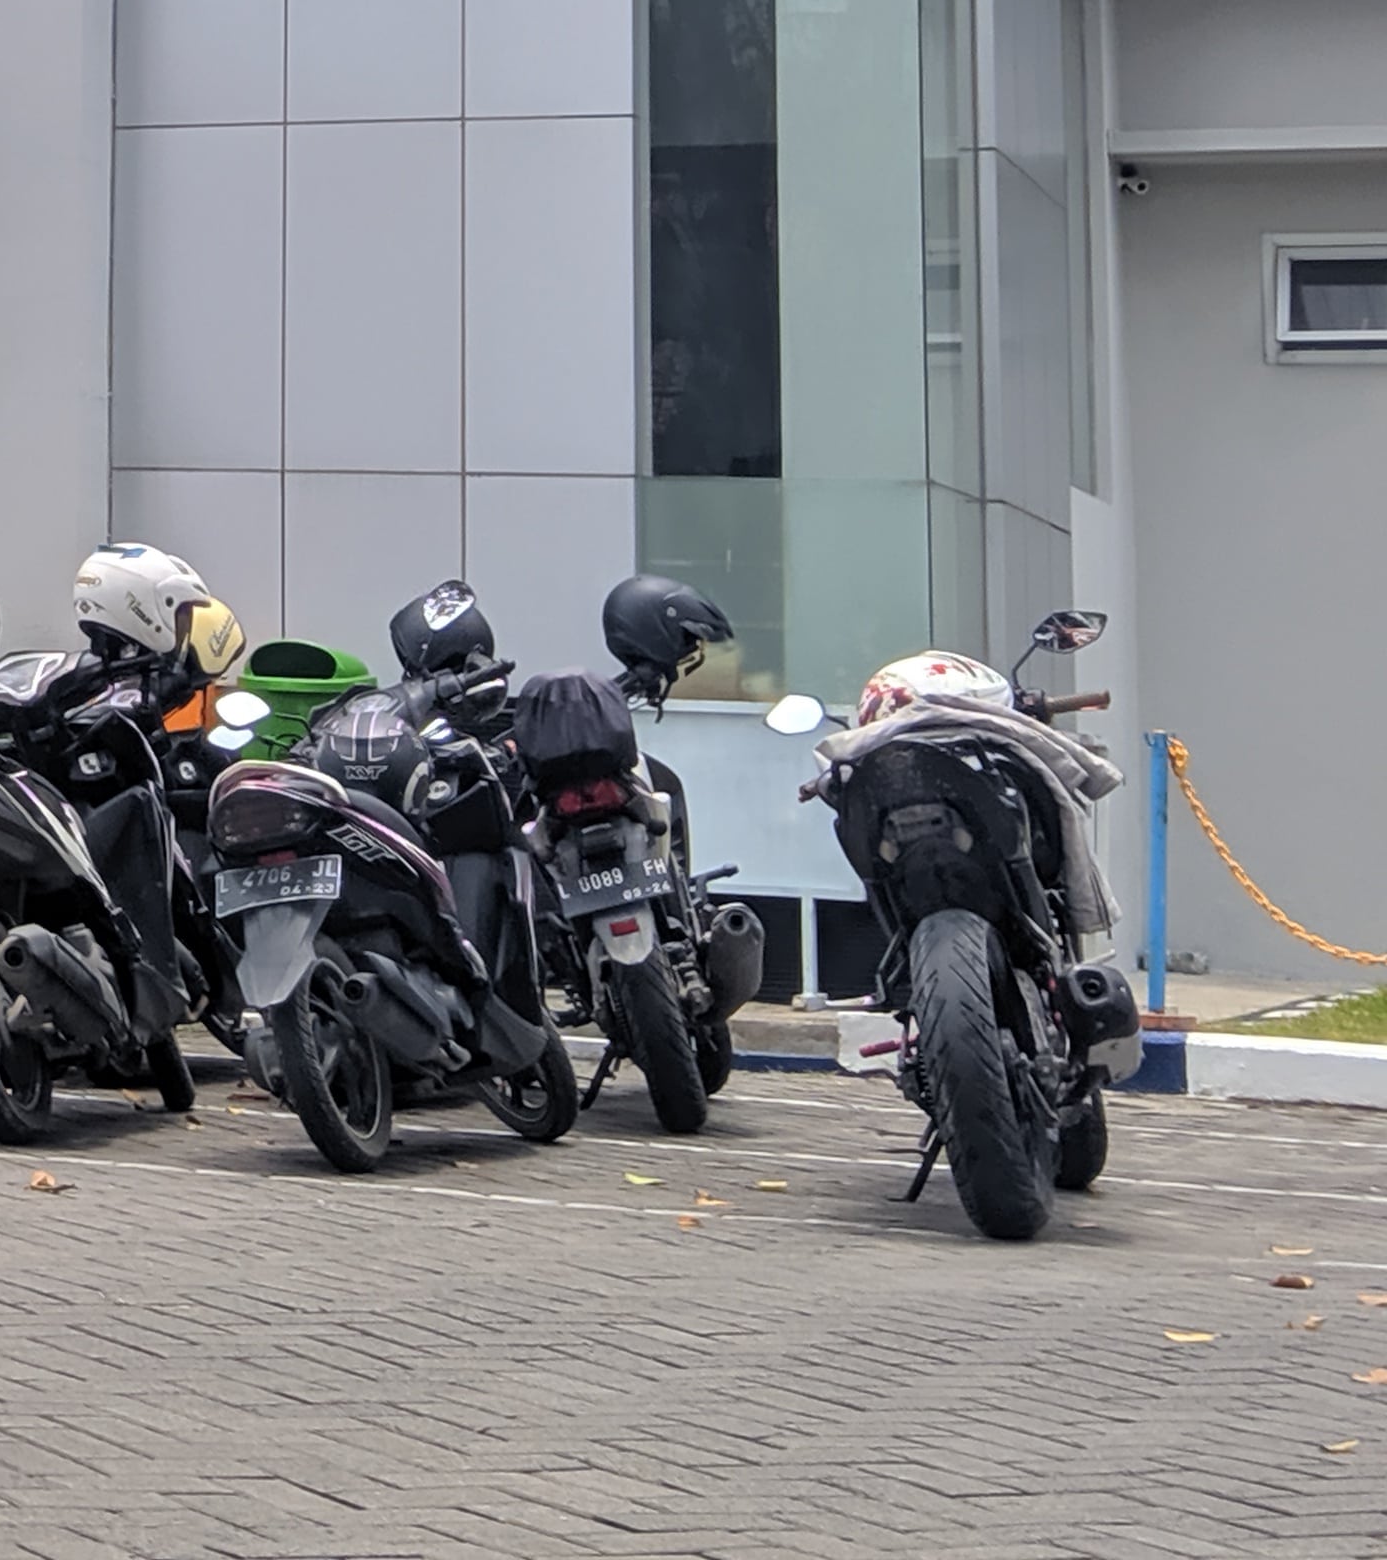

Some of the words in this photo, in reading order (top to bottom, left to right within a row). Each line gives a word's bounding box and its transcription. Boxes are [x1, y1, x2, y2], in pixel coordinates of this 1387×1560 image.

[242, 865, 292, 888] 4706
[311, 859, 337, 877] JL
[556, 882, 571, 900] L
[642, 857, 668, 877] FH
